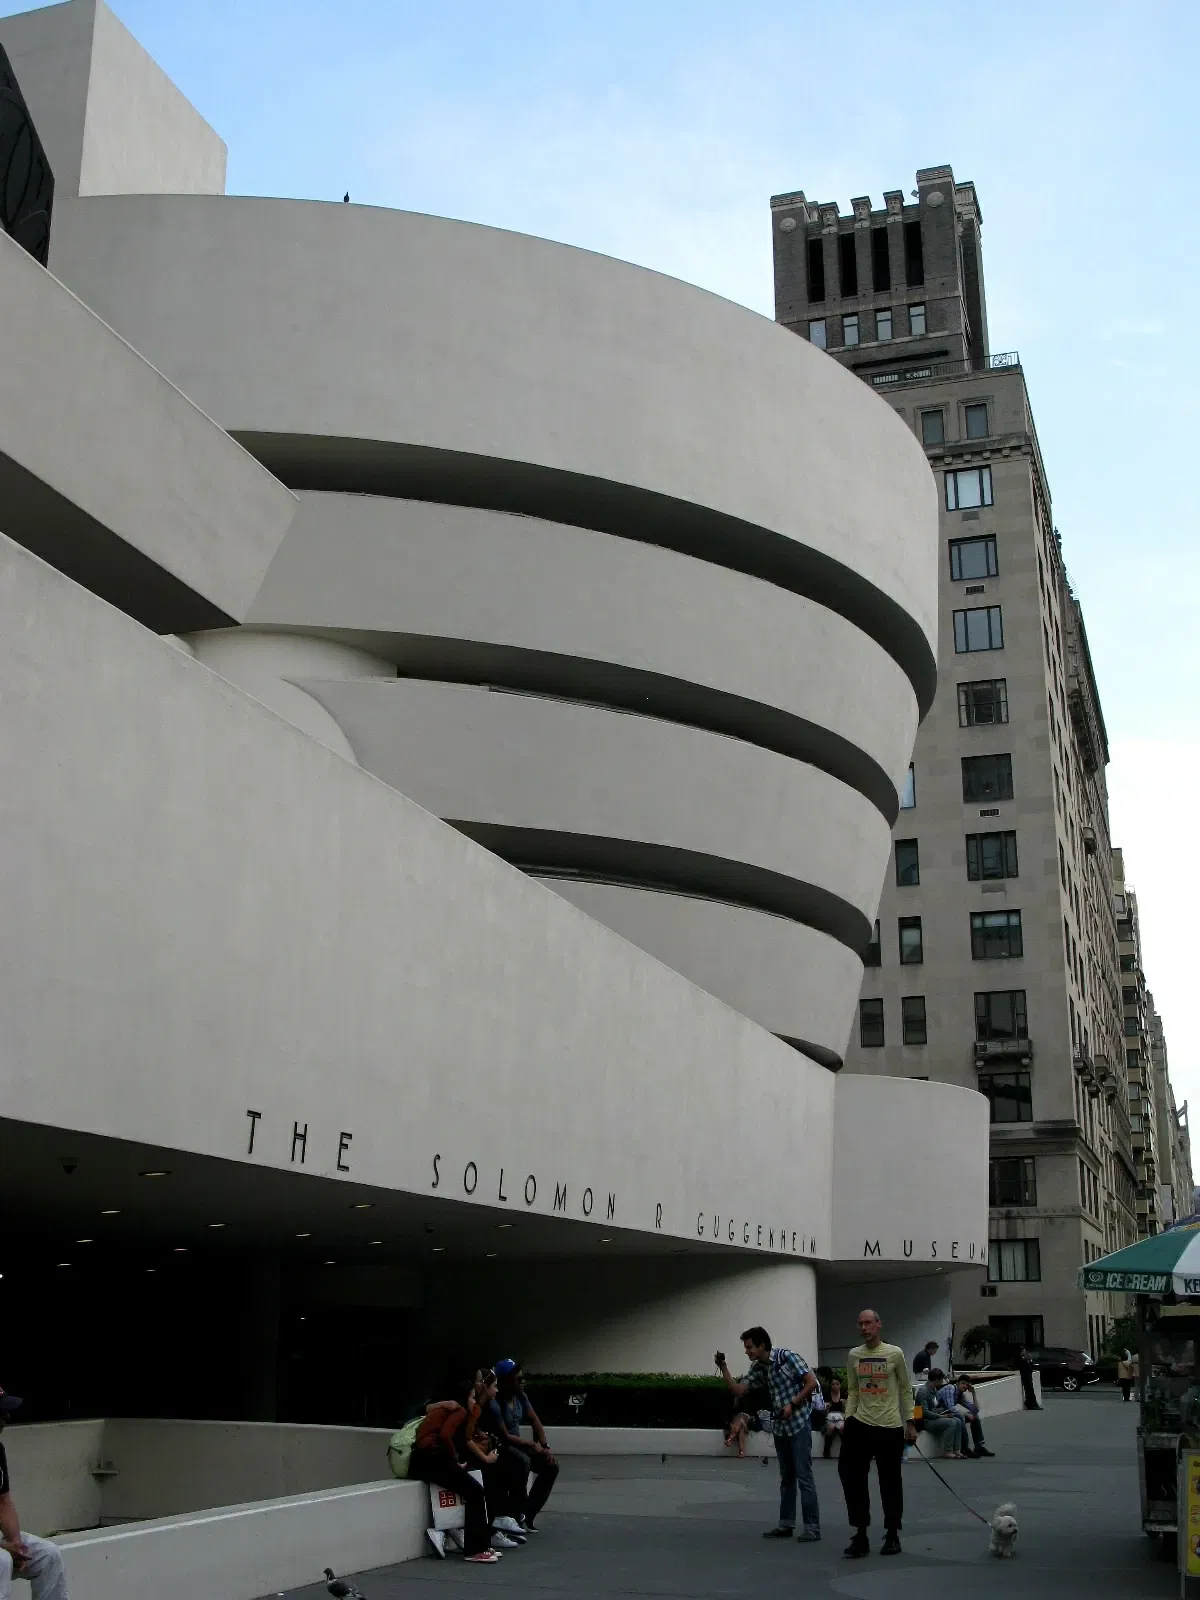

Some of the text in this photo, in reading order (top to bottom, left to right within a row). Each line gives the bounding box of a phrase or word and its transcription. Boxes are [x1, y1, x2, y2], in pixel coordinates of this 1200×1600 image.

[247, 1110, 817, 1255] THE SOLOMON R GUGGENHEIM
[1106, 1272, 1167, 1291] ICE CREAM
